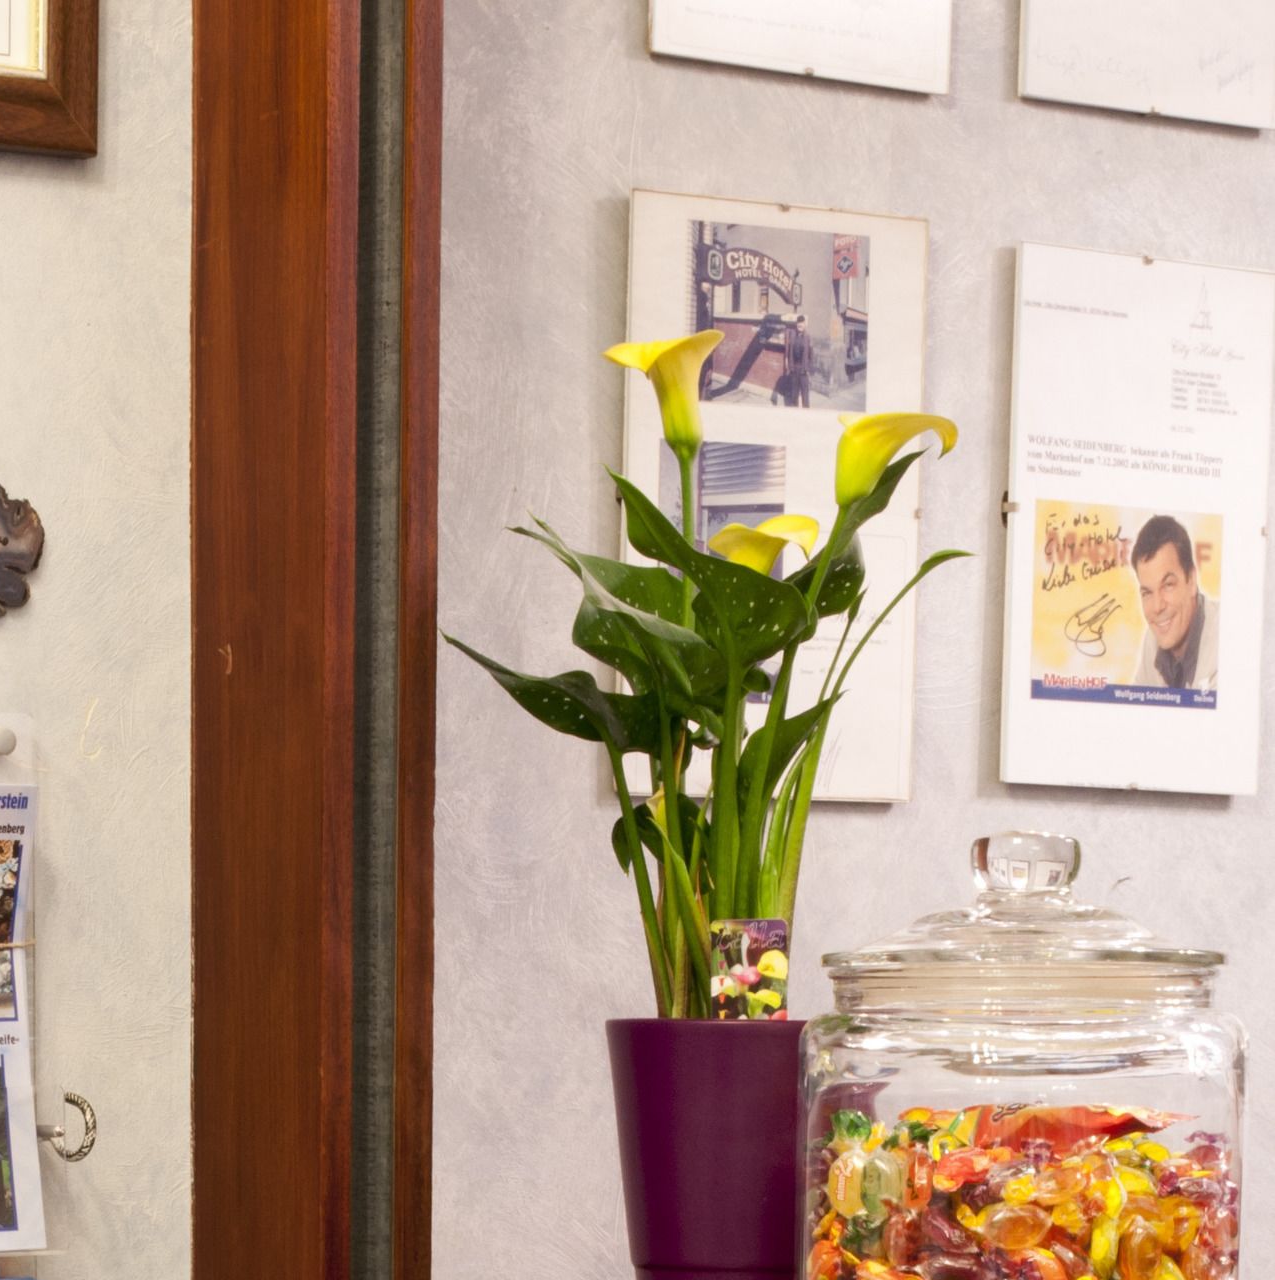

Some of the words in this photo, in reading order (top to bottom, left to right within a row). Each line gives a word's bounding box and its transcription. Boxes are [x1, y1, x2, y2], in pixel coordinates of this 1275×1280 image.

[726, 251, 759, 271] City
[763, 257, 793, 290] Hotel
[1042, 673, 1107, 690] MARIENHOF
